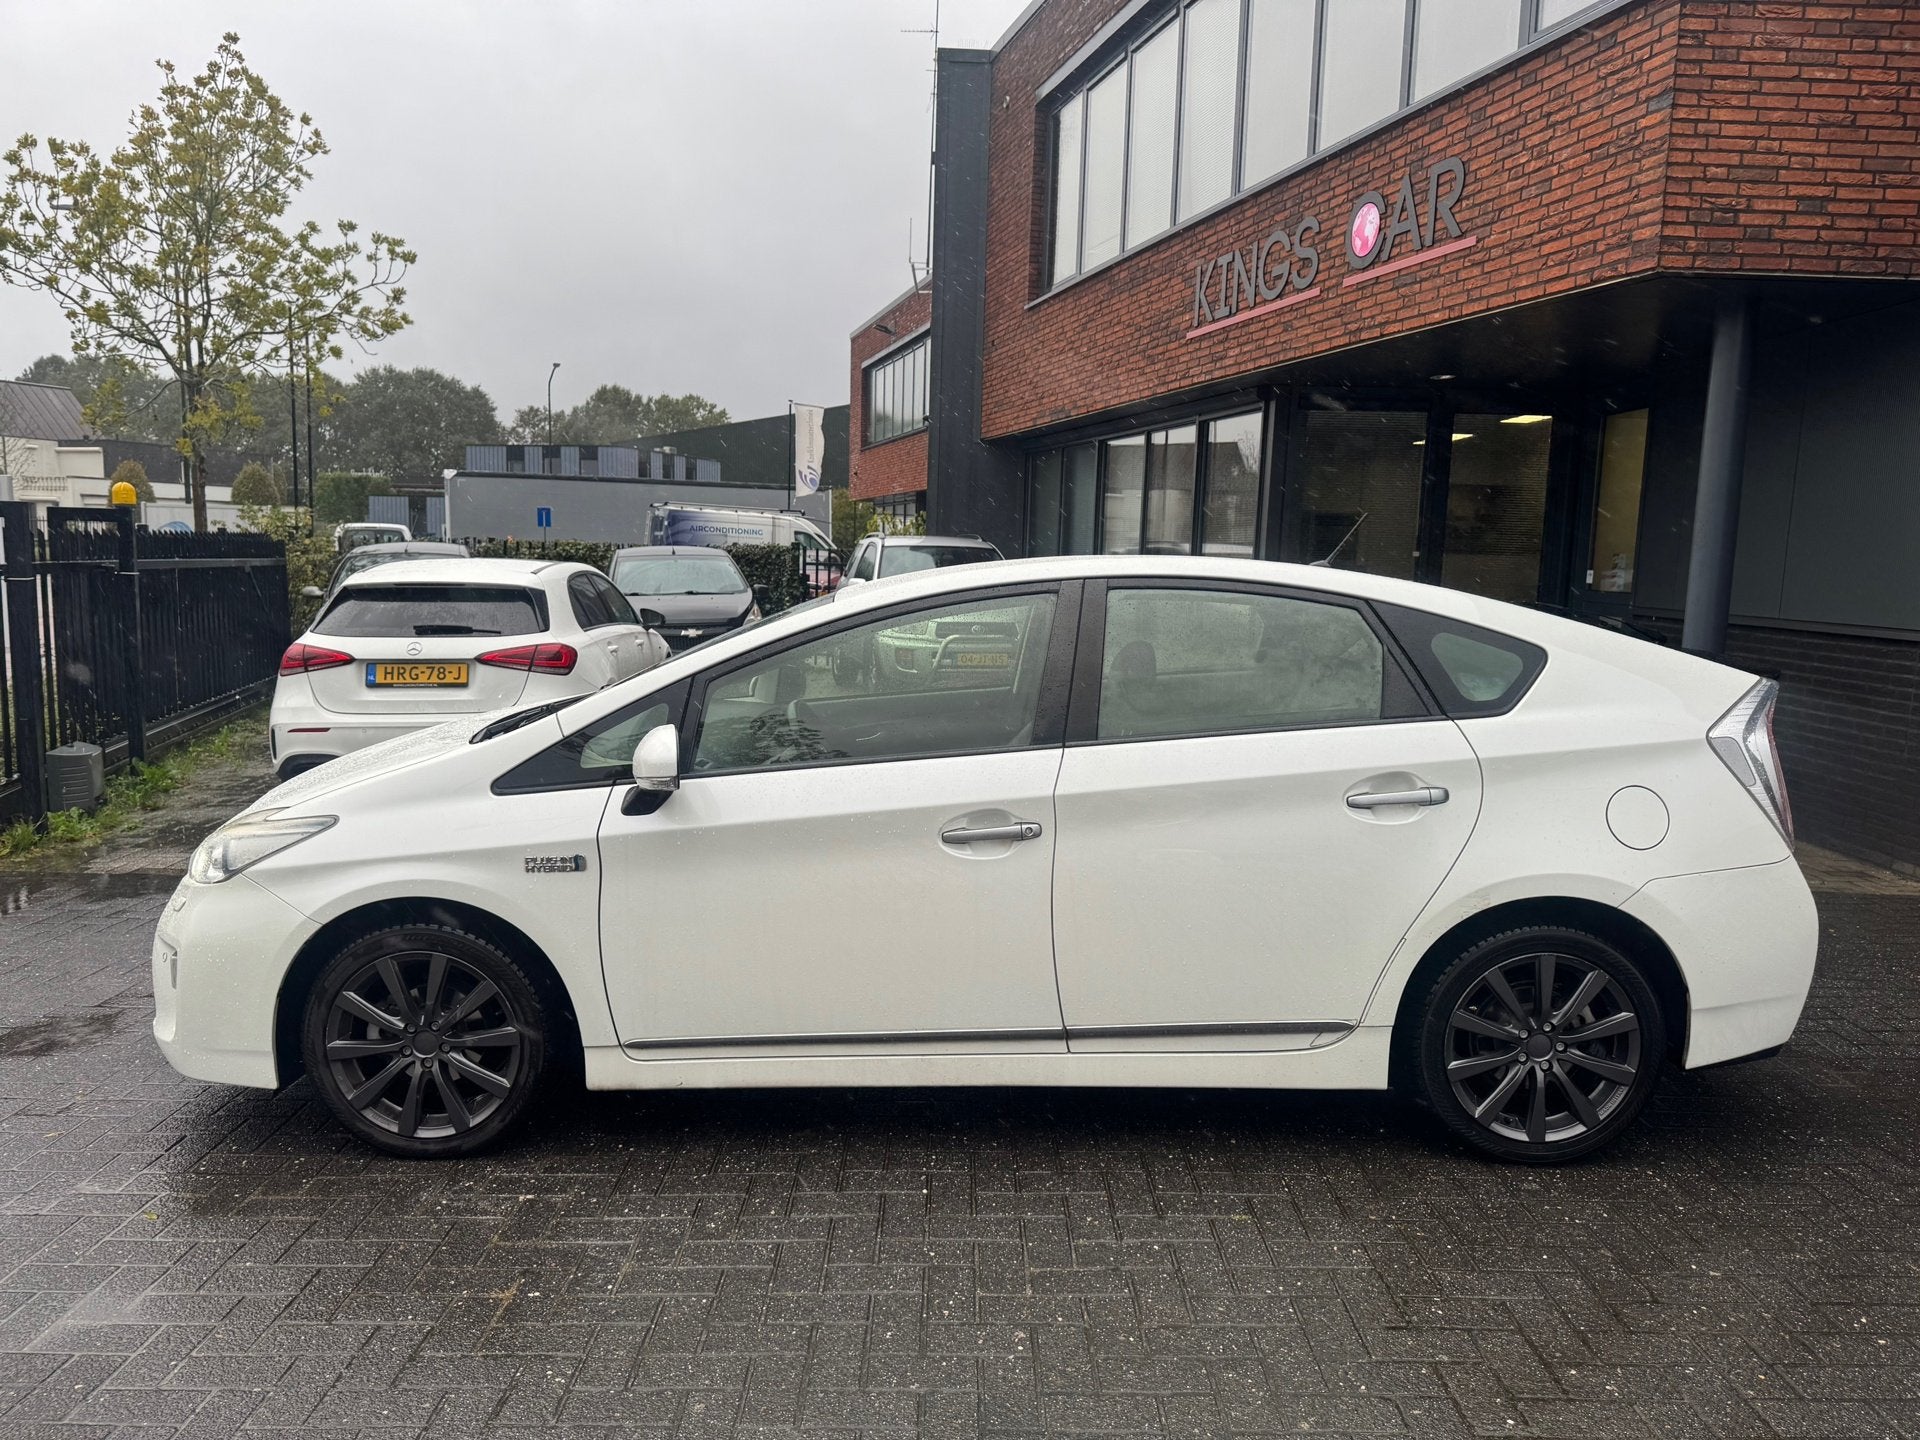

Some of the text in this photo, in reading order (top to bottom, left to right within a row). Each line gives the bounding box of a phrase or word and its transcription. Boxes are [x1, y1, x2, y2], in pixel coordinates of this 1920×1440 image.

[1193, 156, 1465, 328] KINGS CAR
[689, 525, 764, 536] AIRCONDITIONING
[383, 666, 461, 681] HRG-78-J
[525, 856, 573, 865] PLUG-IN
[525, 865, 573, 873] HYBRID
